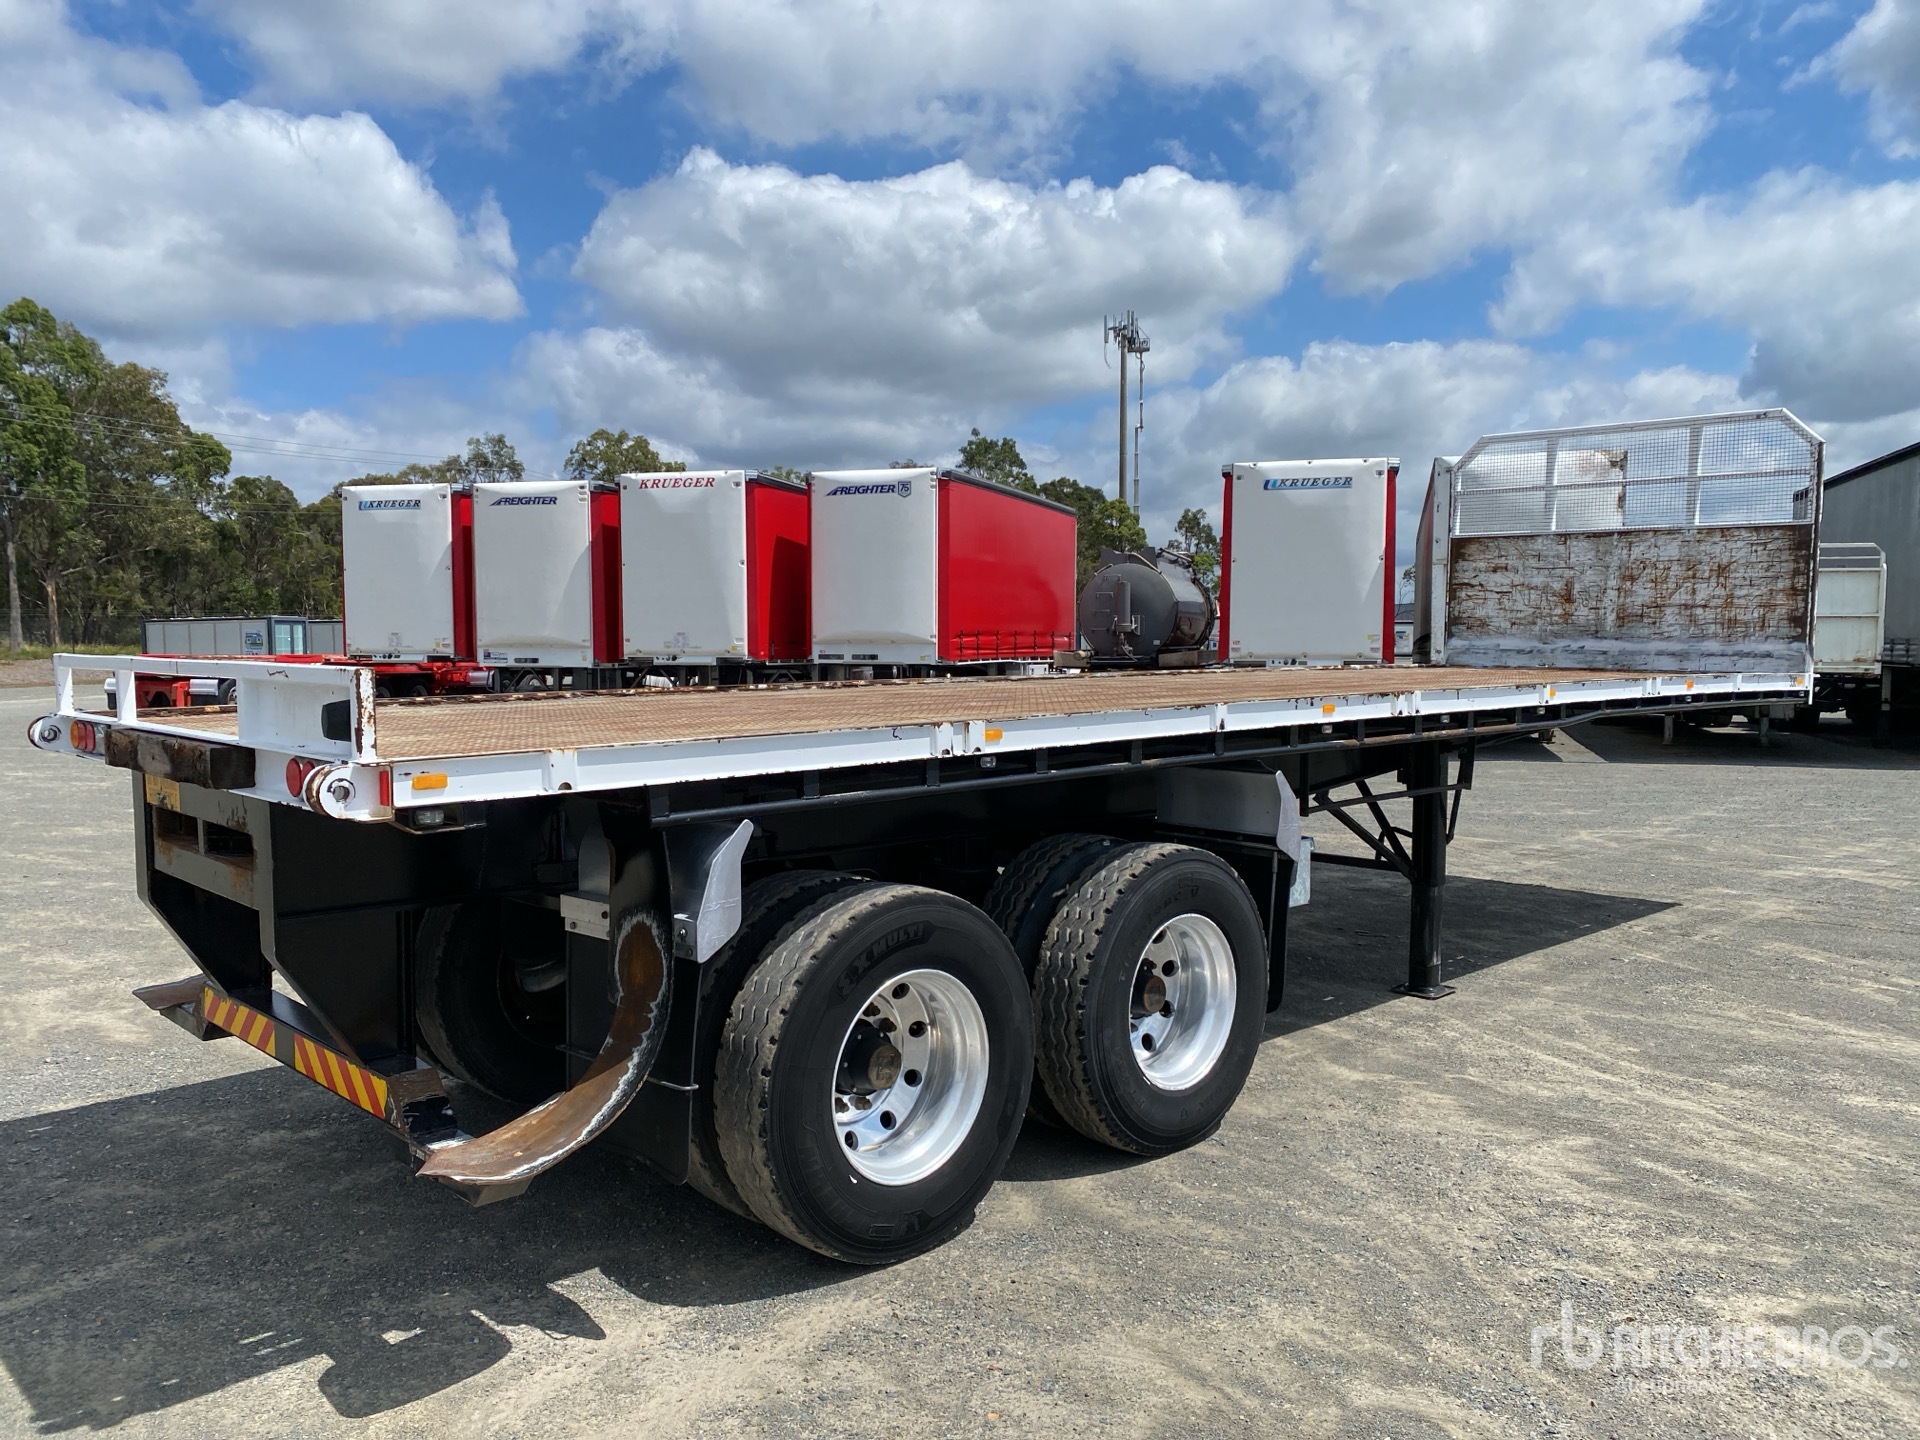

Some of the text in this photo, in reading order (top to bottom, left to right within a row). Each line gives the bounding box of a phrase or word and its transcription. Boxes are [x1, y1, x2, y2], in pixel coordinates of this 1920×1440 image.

[639, 477, 715, 489] KRUEGER
[1278, 477, 1352, 487] KRUEGER
[834, 484, 896, 495] FREIGHTER
[367, 499, 421, 508] KRUEGER
[499, 496, 558, 506] FREIGHTER
[872, 924, 924, 956] MULTI
